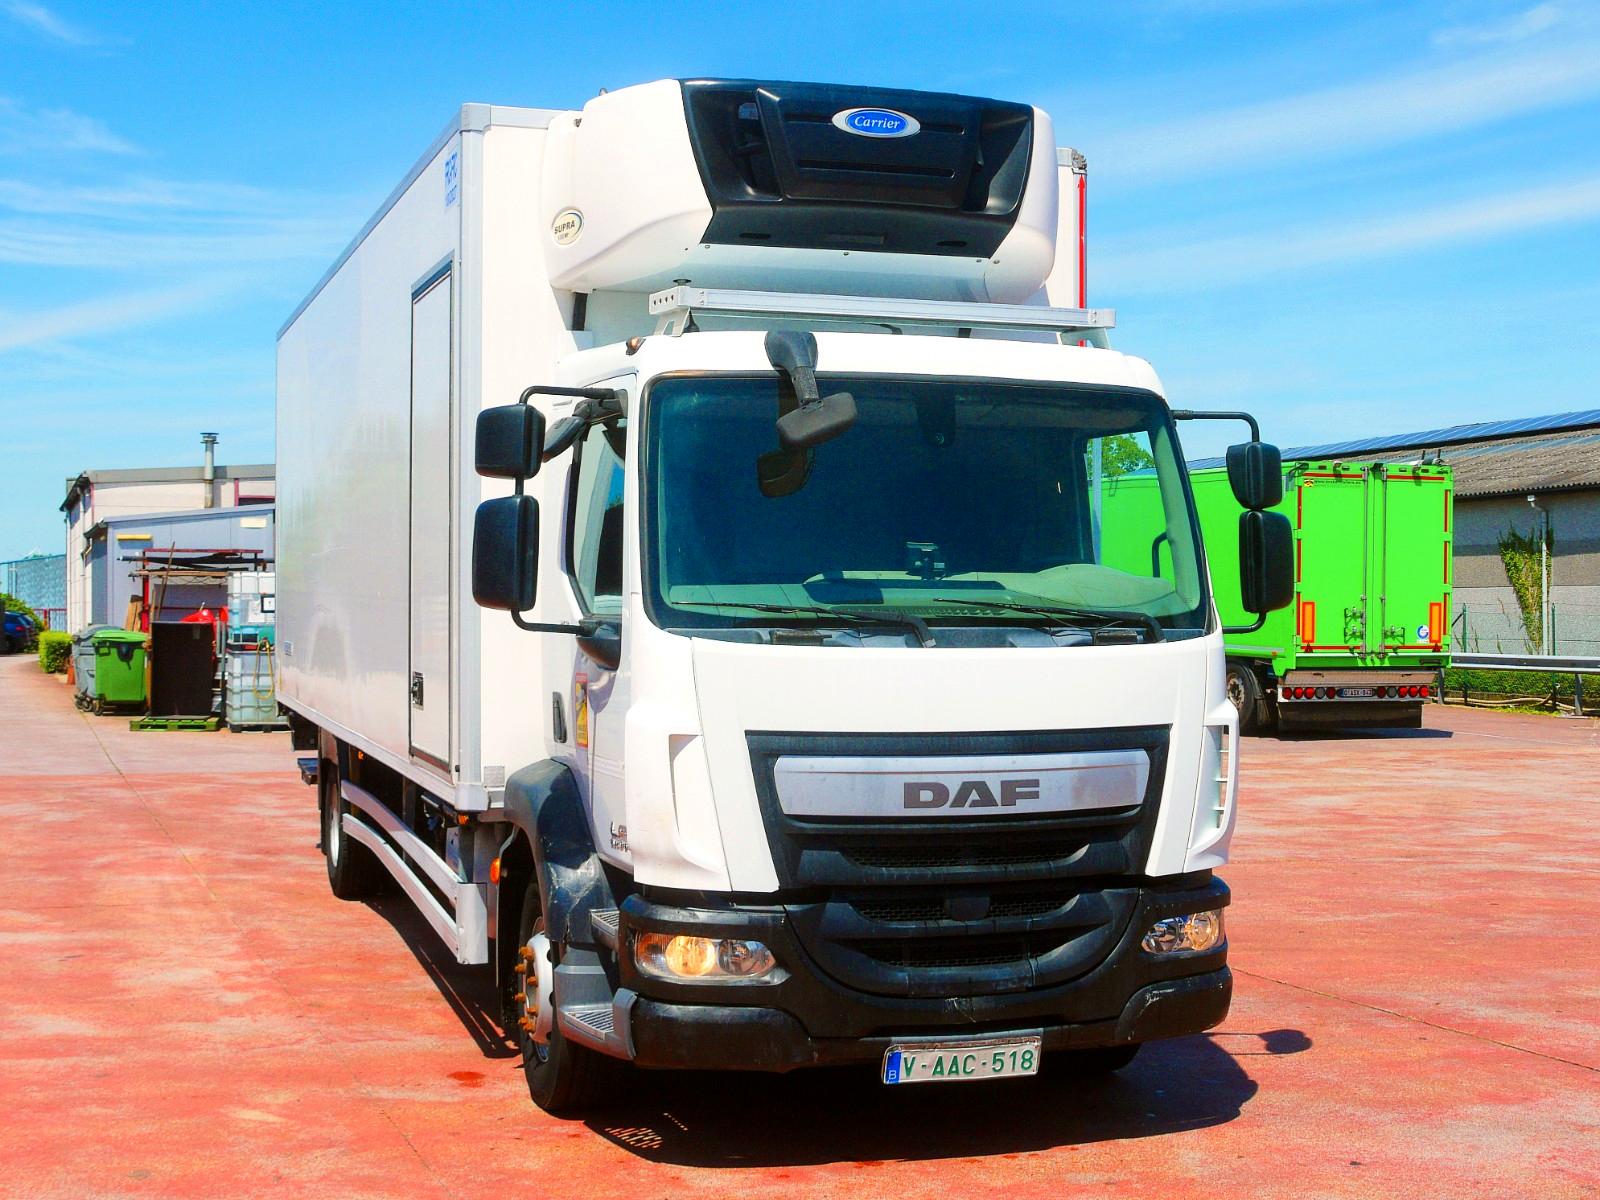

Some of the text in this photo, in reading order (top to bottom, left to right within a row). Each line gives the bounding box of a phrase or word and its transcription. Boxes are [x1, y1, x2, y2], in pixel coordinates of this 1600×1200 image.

[854, 115, 901, 129] Carrier
[554, 219, 576, 235] SUPRA
[903, 778, 1040, 809] DAF
[903, 1049, 1034, 1077] V-AAC-518
[888, 1069, 897, 1080] B
